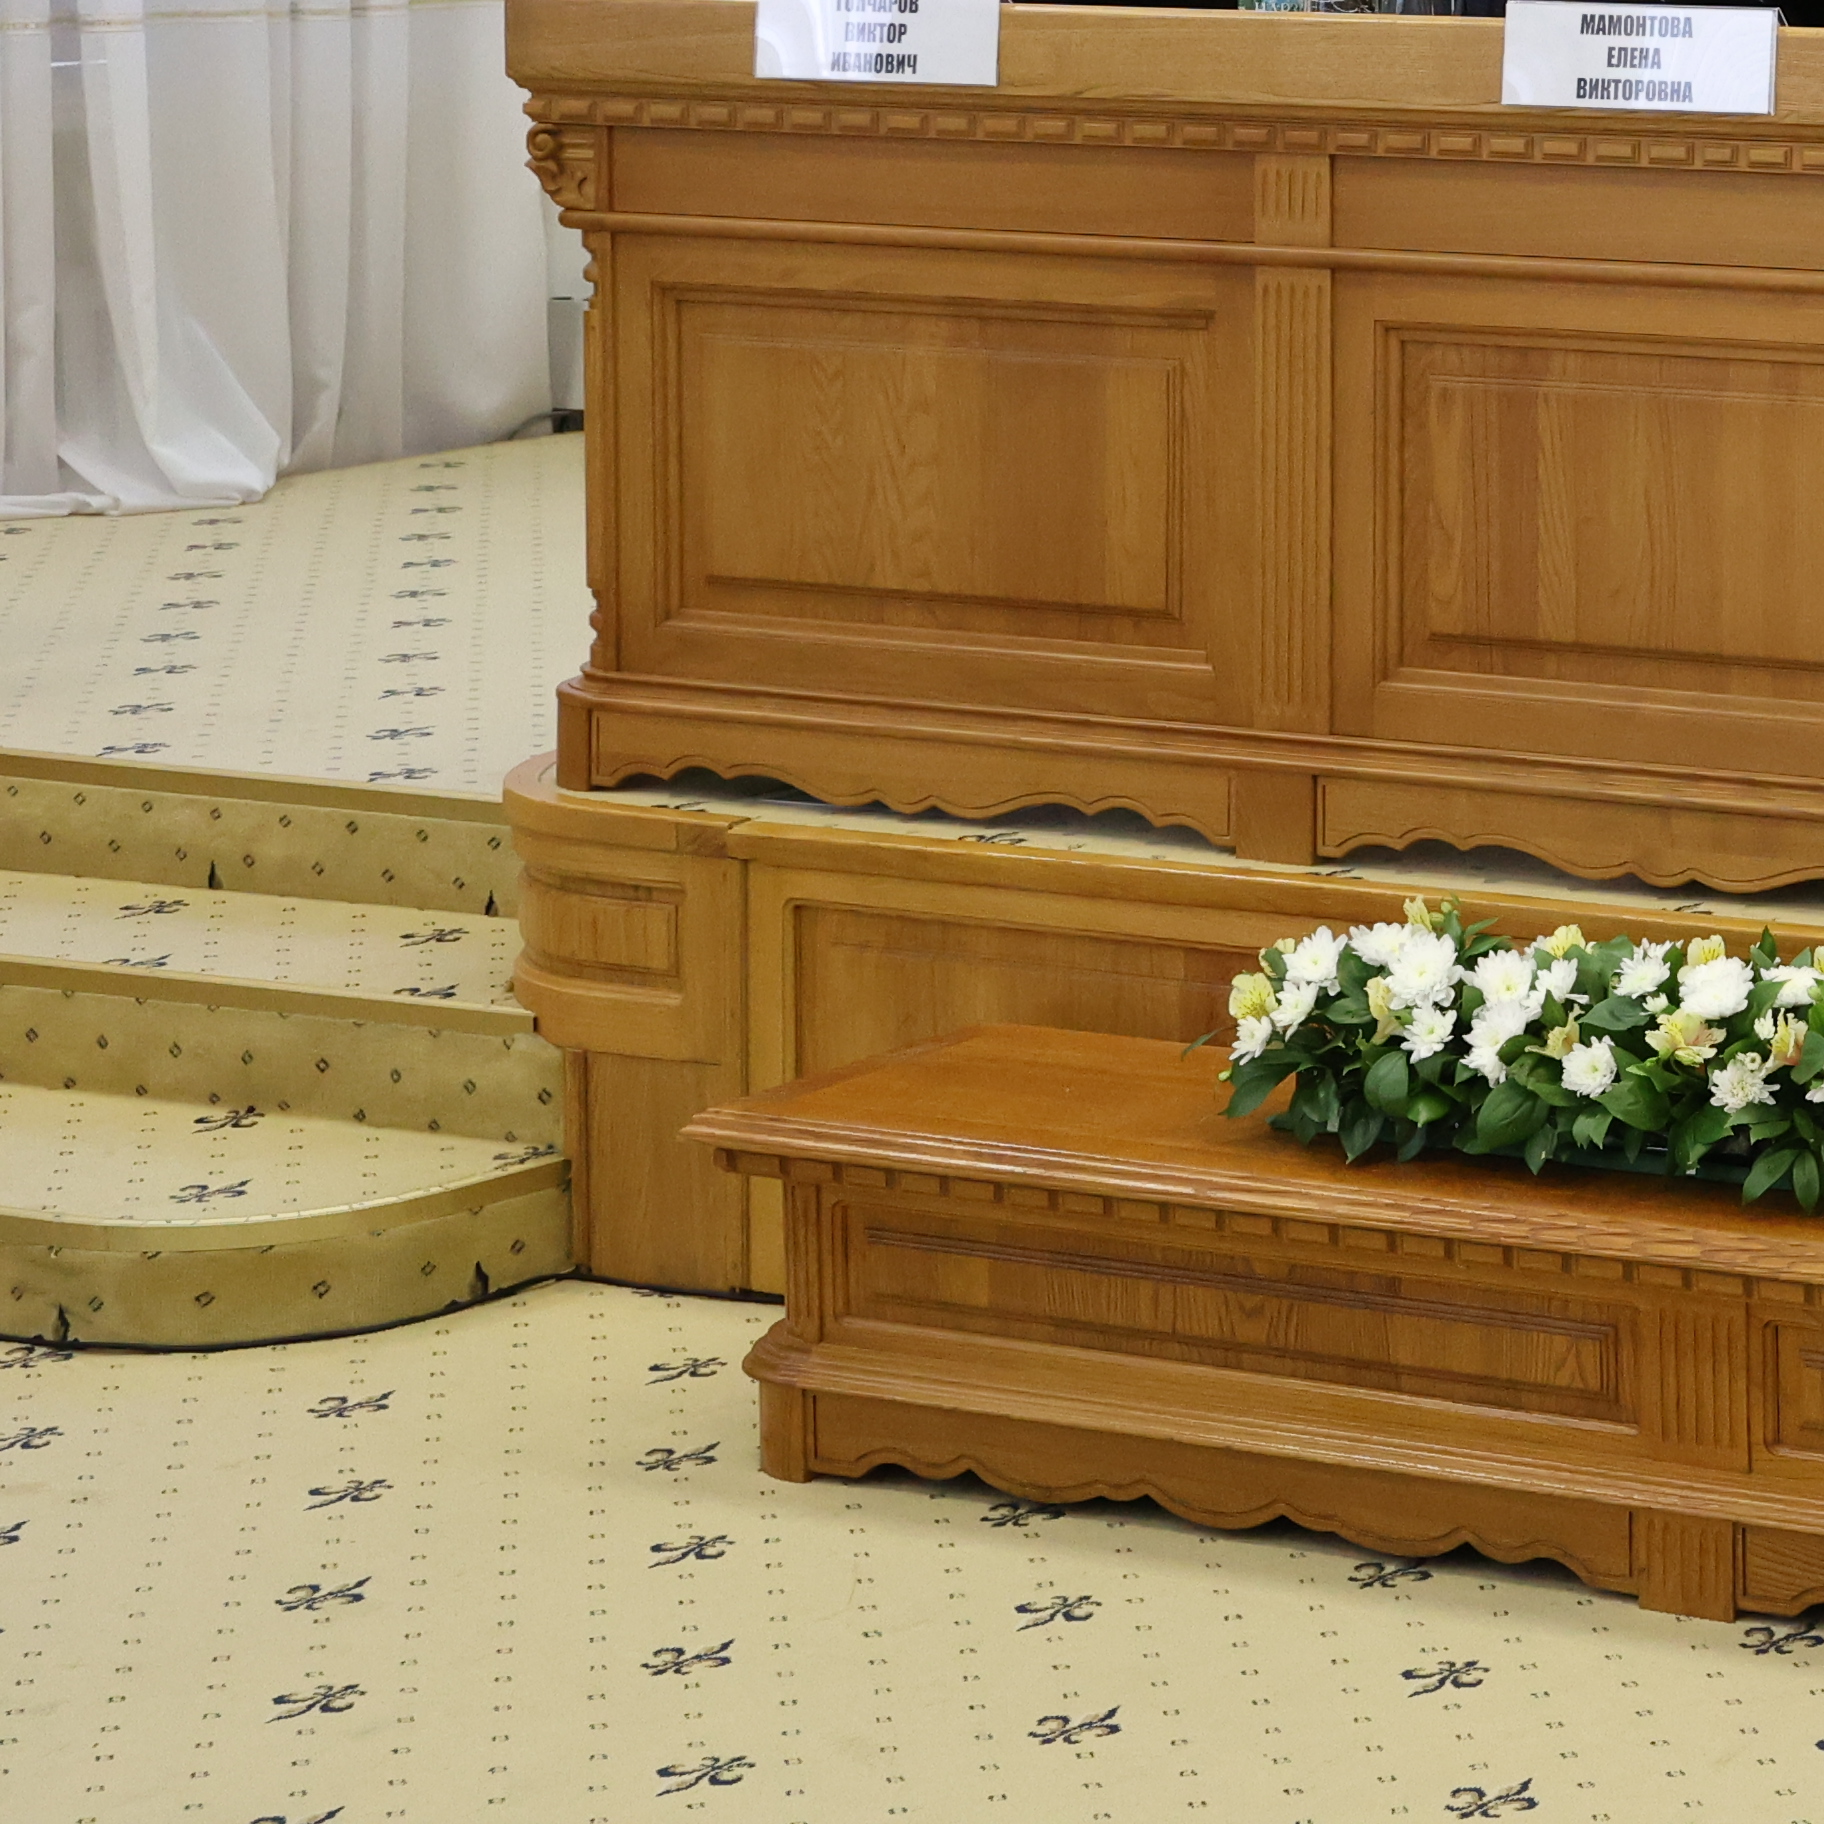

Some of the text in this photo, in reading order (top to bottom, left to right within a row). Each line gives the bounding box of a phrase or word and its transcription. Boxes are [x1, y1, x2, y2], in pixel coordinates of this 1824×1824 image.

[845, 21, 908, 44] ВИКТОР
[1579, 13, 1694, 38] МАМОНТОВА
[830, 52, 918, 75] ИВАНОВИЧ
[1606, 46, 1662, 70] ЕЛЕНА
[1575, 77, 1694, 103] ВИКТОРОВНА
